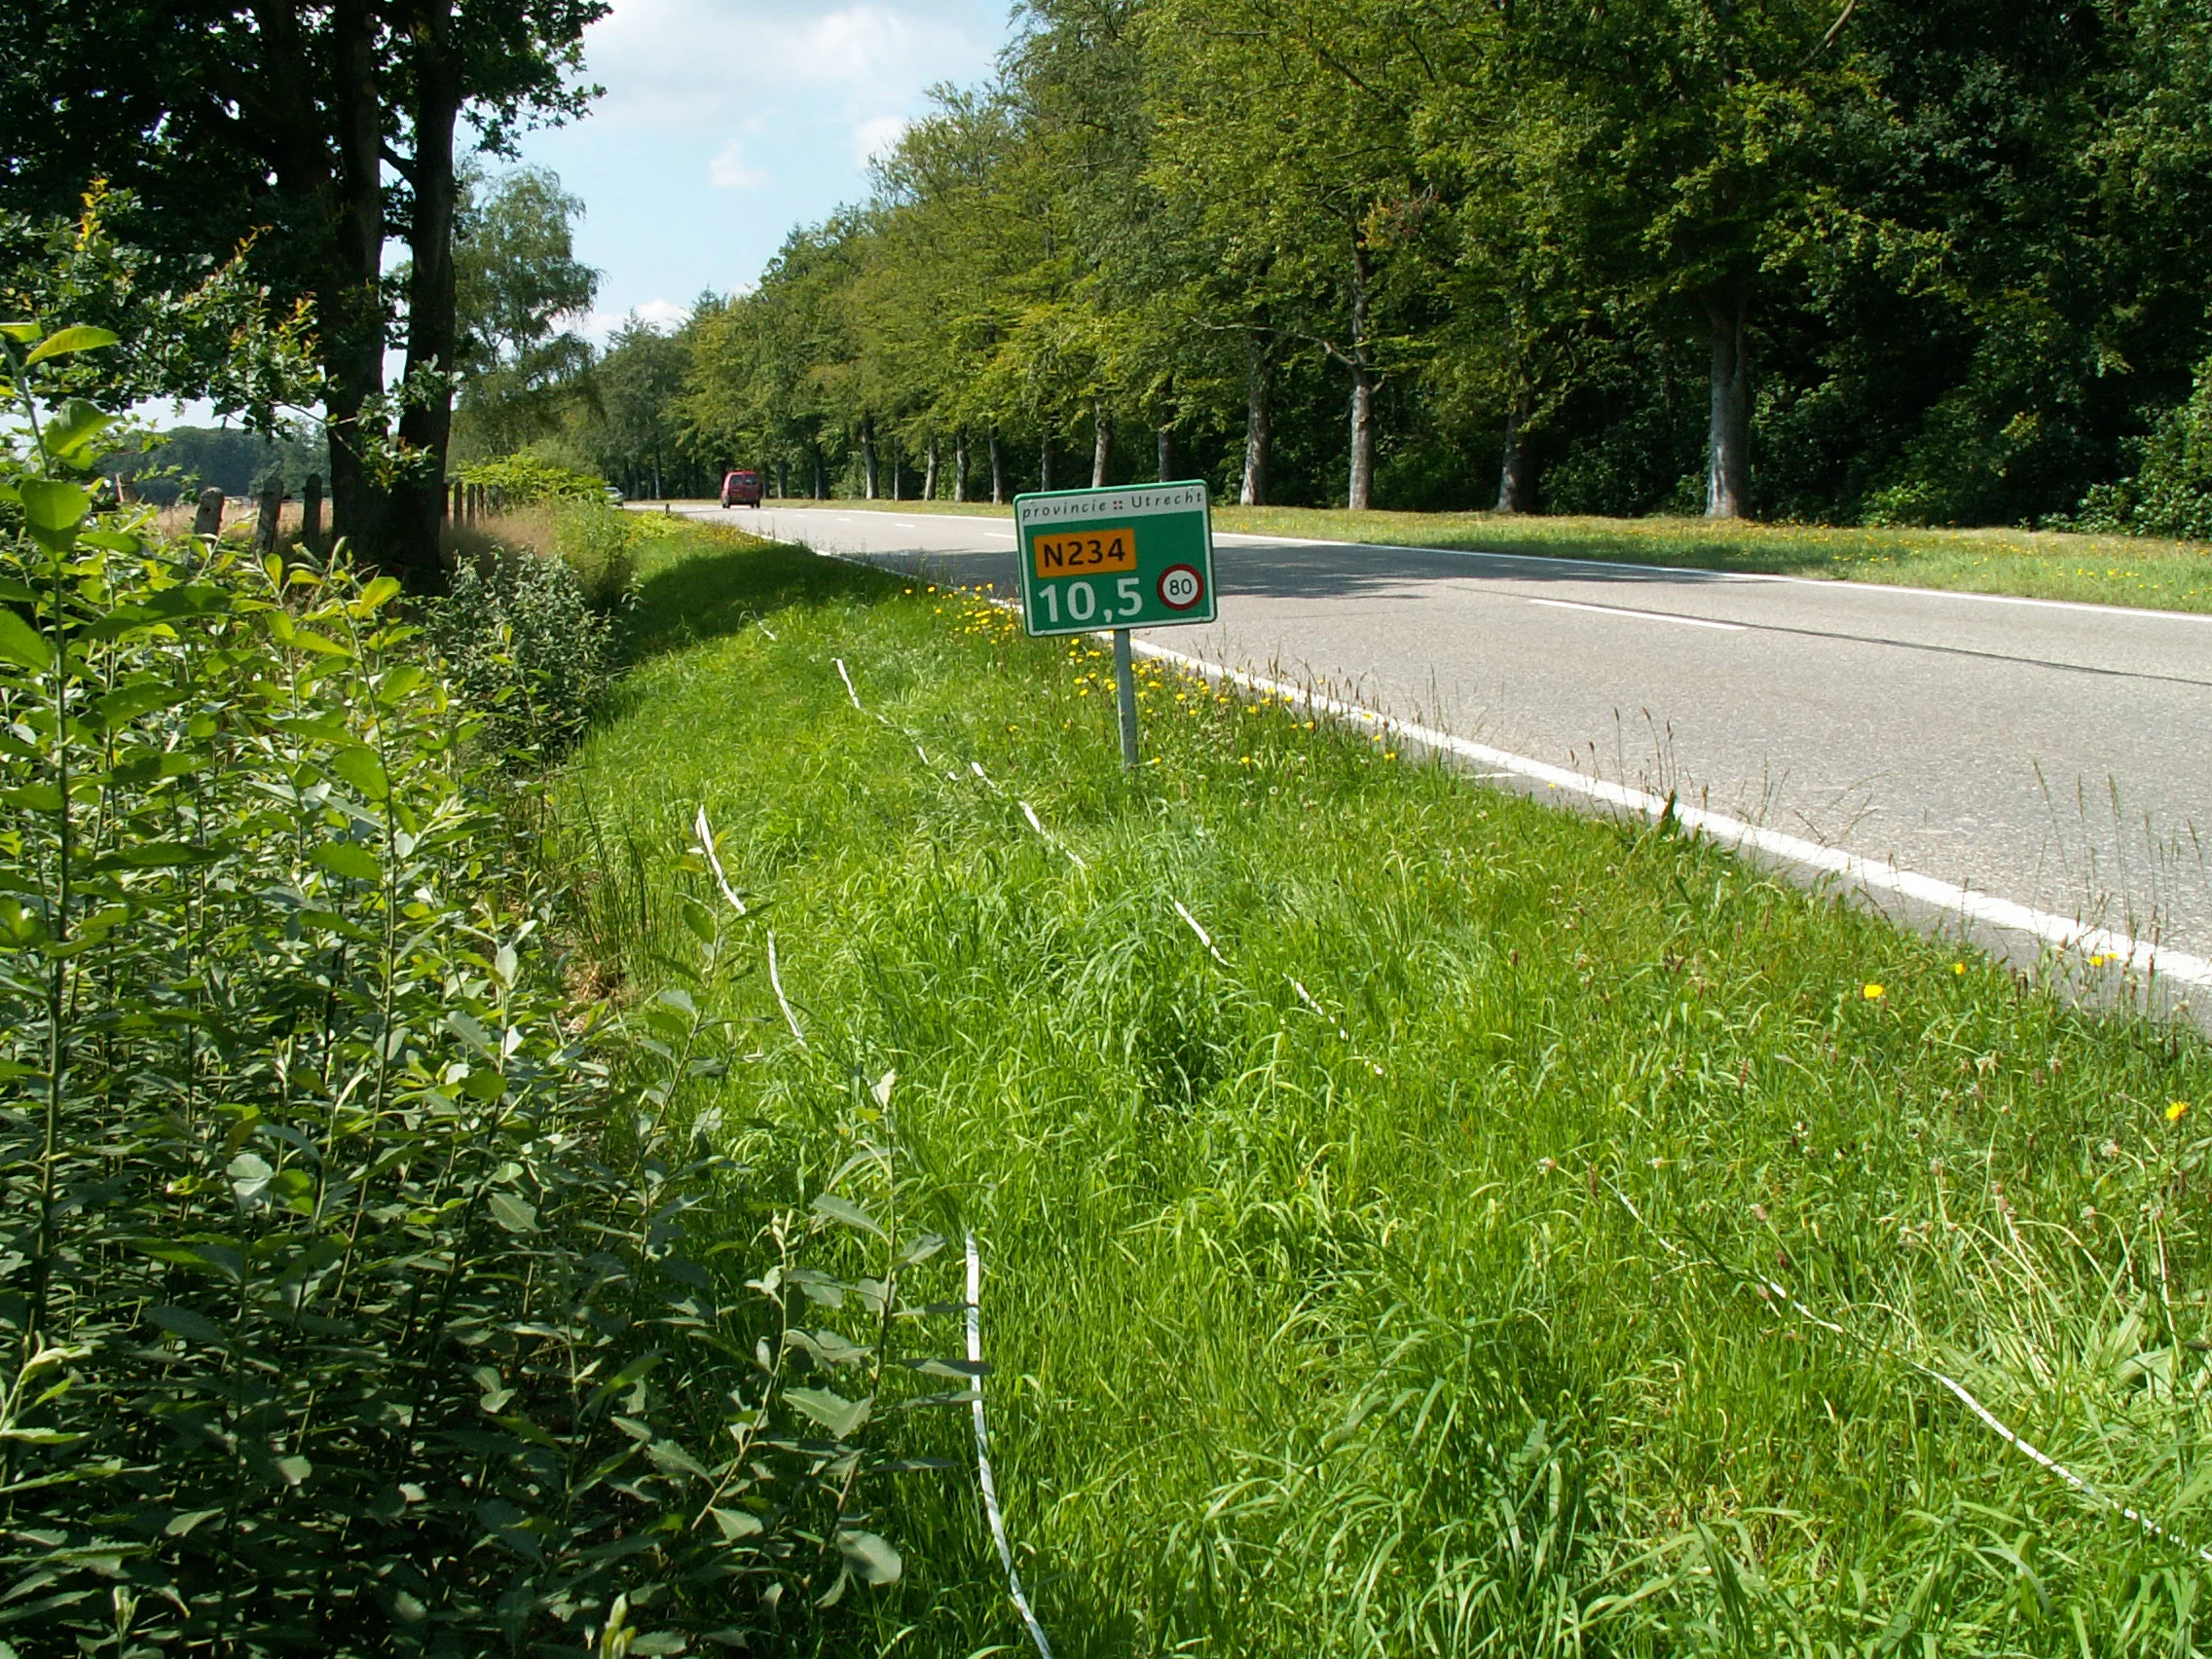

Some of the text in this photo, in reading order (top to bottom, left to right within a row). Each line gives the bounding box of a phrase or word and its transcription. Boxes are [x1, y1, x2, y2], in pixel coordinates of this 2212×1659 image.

[1022, 491, 1202, 522] provincie Utrecht
[1043, 537, 1125, 568] N234
[1038, 577, 1143, 623] 10,5
[1169, 578, 1193, 596] 80
